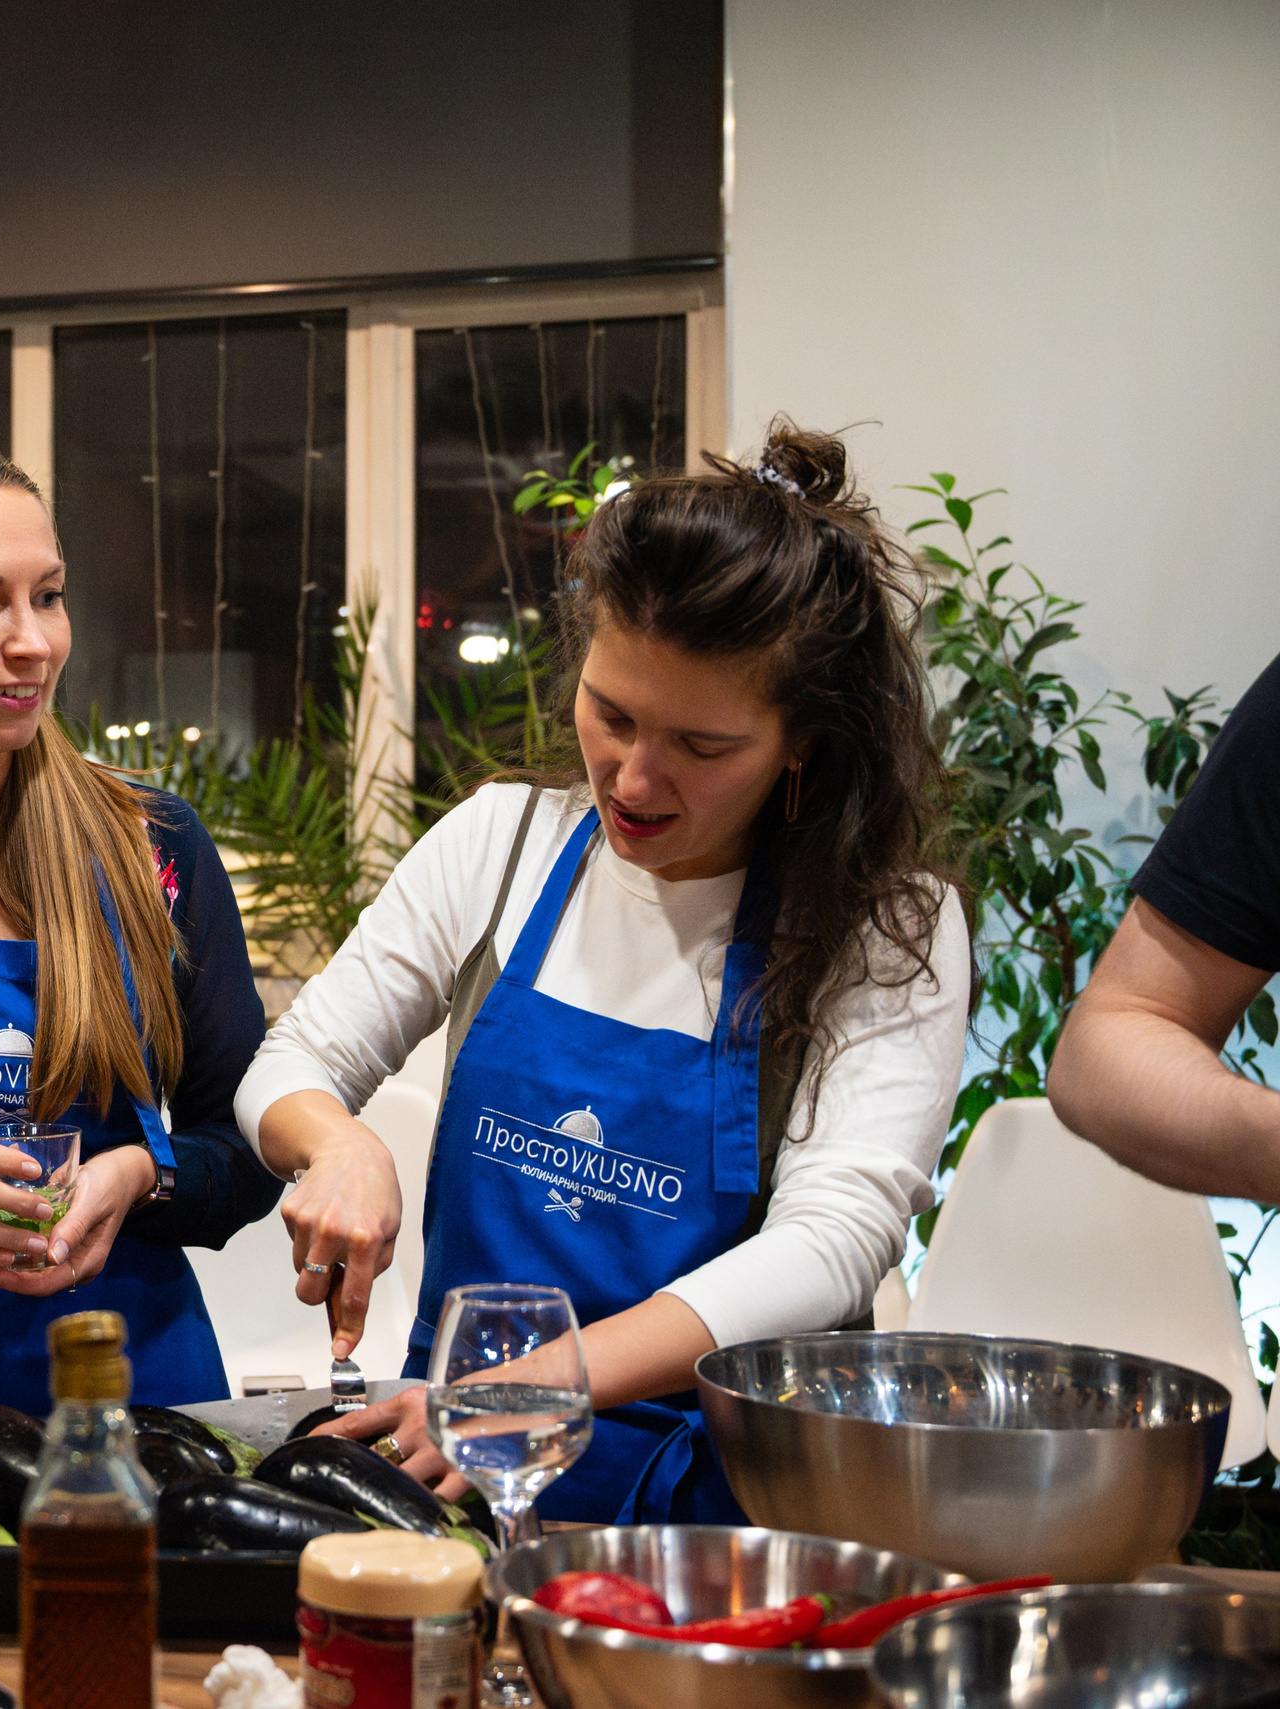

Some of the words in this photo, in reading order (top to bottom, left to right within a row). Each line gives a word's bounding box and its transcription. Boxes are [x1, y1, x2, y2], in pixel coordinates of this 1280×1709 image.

[475, 1115, 682, 1202] ПростоVKUSNO
[520, 1163, 580, 1193] КУЛИНАРНАЯ
[581, 1184, 617, 1204] СТУДИЯ
